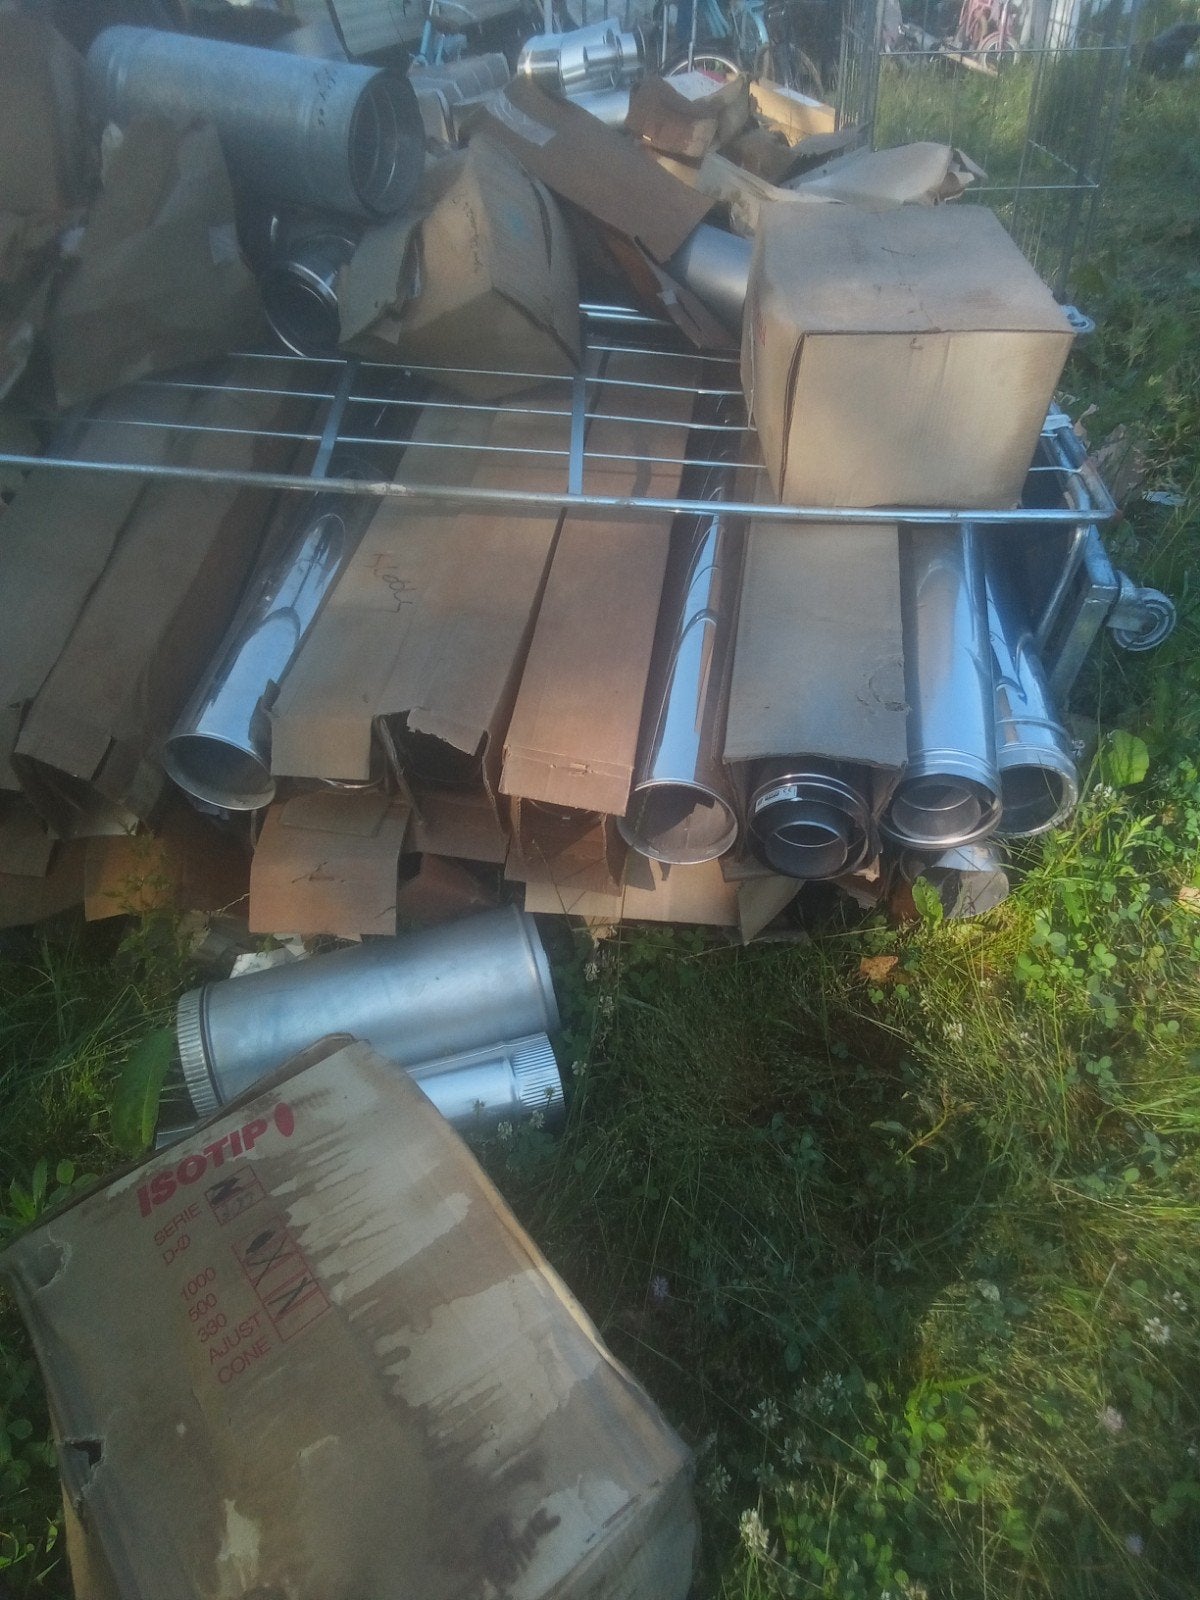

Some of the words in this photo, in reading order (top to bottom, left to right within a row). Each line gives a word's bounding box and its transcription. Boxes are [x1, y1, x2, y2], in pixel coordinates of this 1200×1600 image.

[137, 1118, 268, 1218] ISOTIP
[154, 1203, 202, 1247] SERIE
[181, 1267, 216, 1302] 1000
[188, 1293, 217, 1323] 500
[208, 1313, 261, 1364] AJUST
[218, 1337, 271, 1384] CONE
